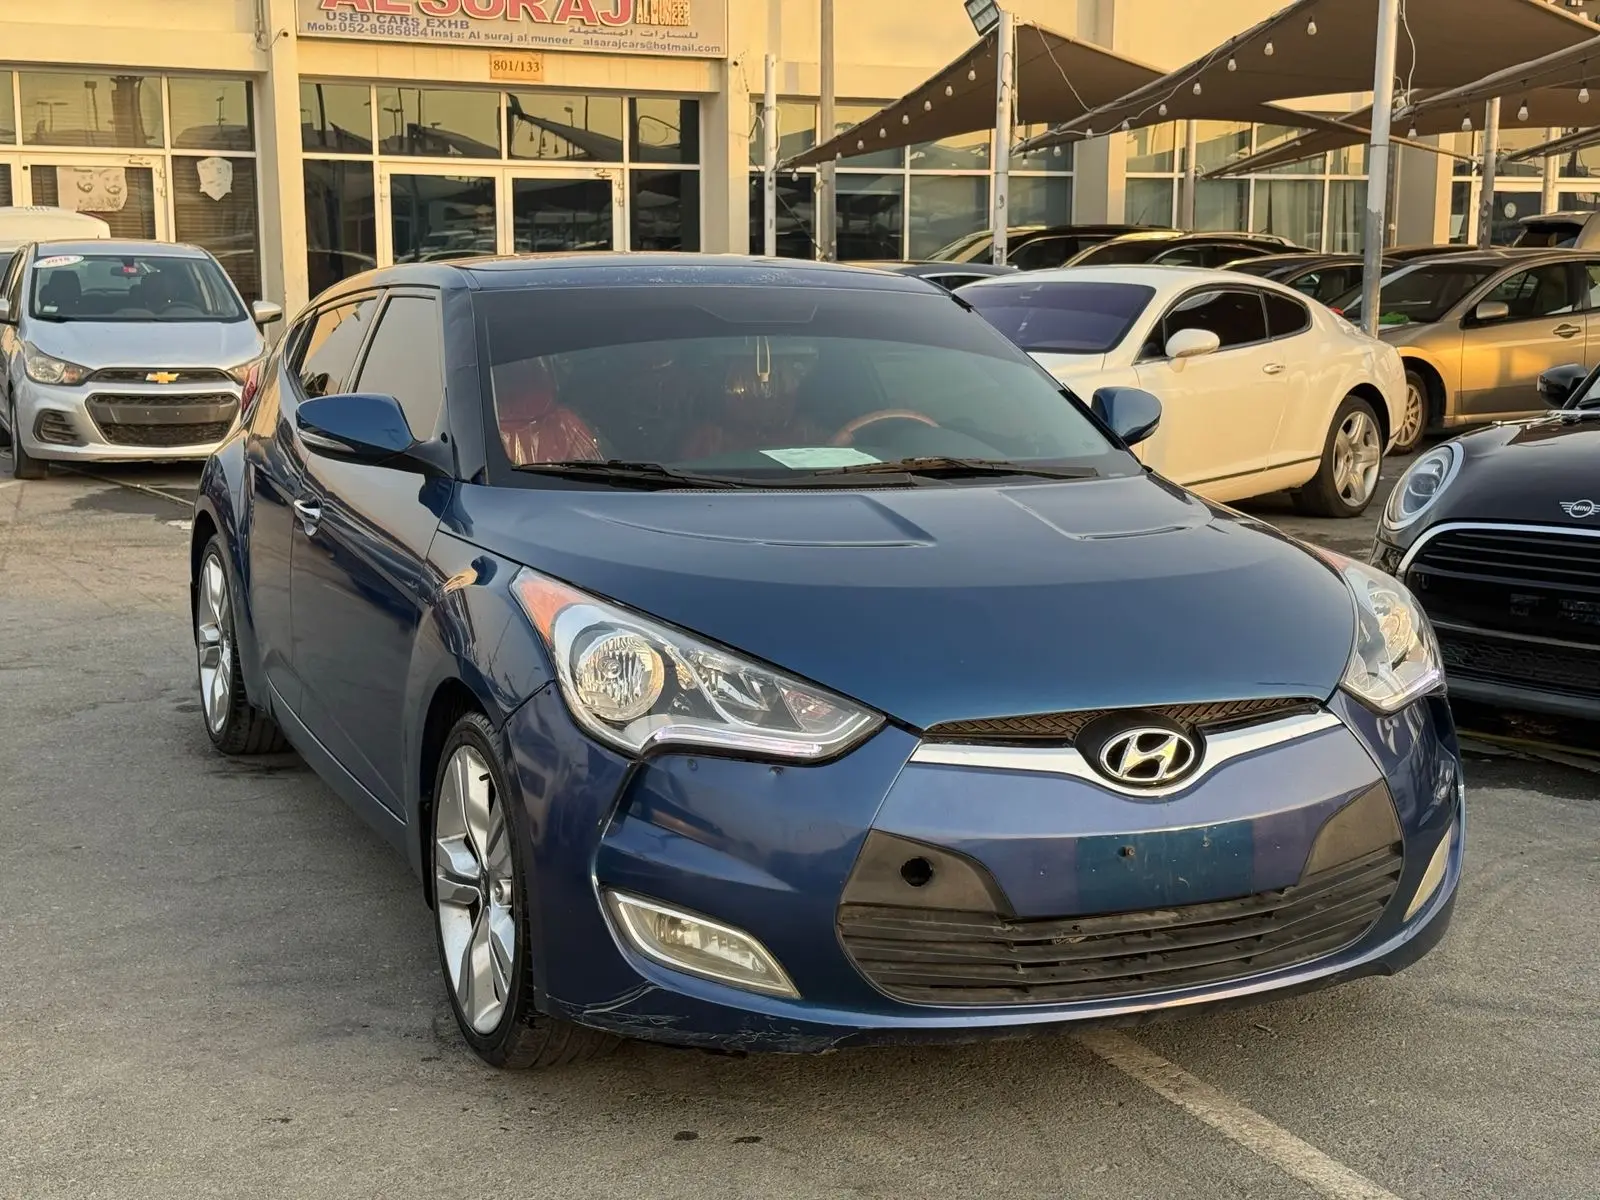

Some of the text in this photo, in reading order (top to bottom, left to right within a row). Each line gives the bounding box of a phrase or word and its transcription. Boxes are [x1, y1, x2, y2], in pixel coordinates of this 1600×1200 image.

[325, 11, 470, 29] USED CARS EXHB
[307, 22, 337, 32] Mob:
[431, 28, 465, 39] Insta:
[468, 31, 480, 40] Al
[484, 32, 513, 43] suraj
[531, 36, 573, 45] muneer
[493, 59, 540, 73] 801/133
[1572, 504, 1591, 512] MINI
